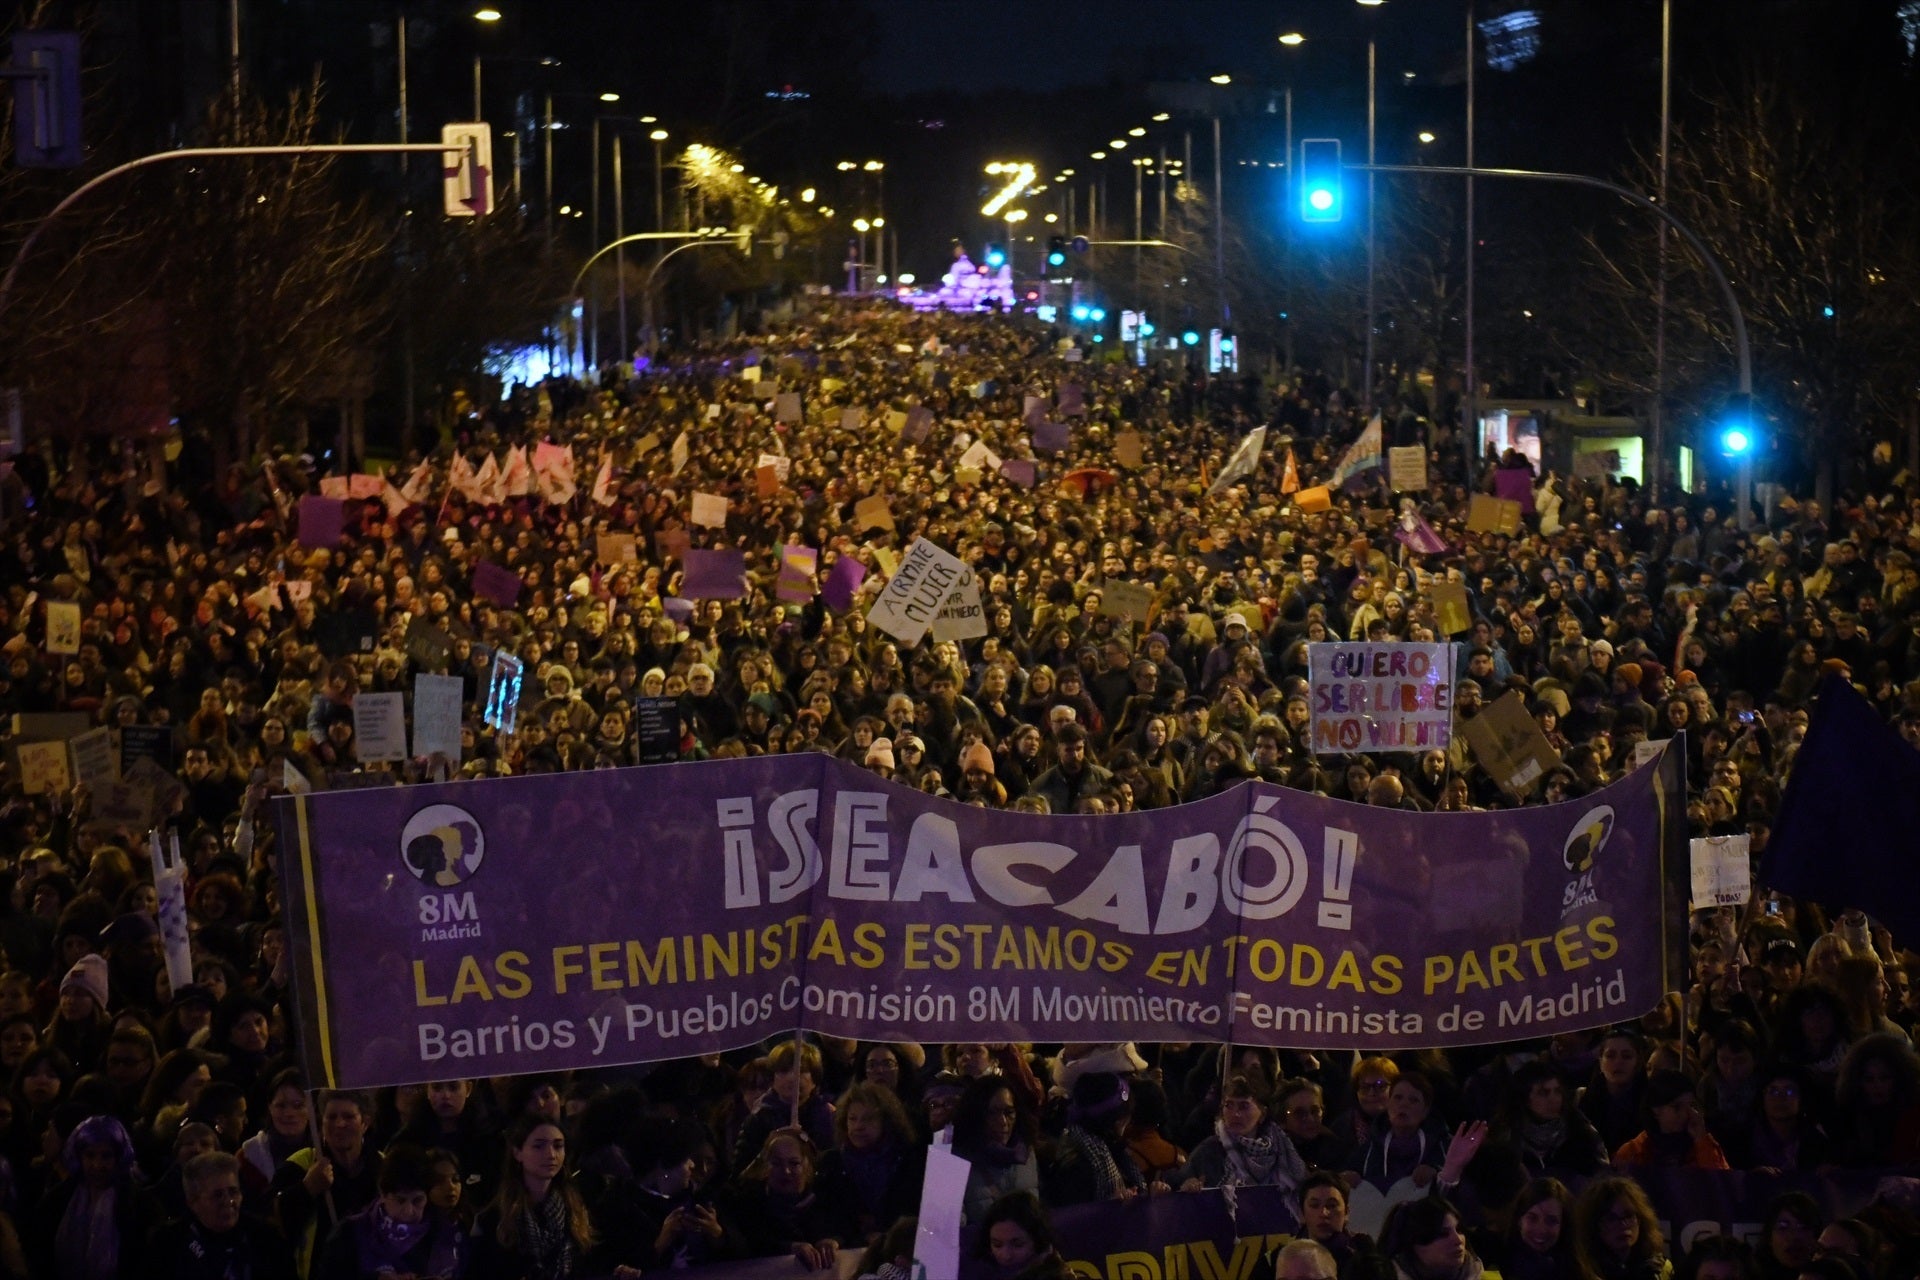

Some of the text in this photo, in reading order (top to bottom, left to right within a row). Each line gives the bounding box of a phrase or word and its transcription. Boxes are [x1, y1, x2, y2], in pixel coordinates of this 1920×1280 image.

[905, 563, 957, 623] MUJER
[1331, 647, 1430, 678] QUIERO
[1316, 681, 1449, 713] SER LIBRE
[1317, 718, 1362, 749] NO
[419, 891, 479, 924] 8M
[422, 923, 481, 942] Madrid
[412, 914, 1619, 1007] LAS FEMINISTAS ESTAMOS EN TODAS PARTES
[418, 968, 1626, 1061] Barrios y Pueblos Comisión 8M Movimiento Feminista de Madrid
